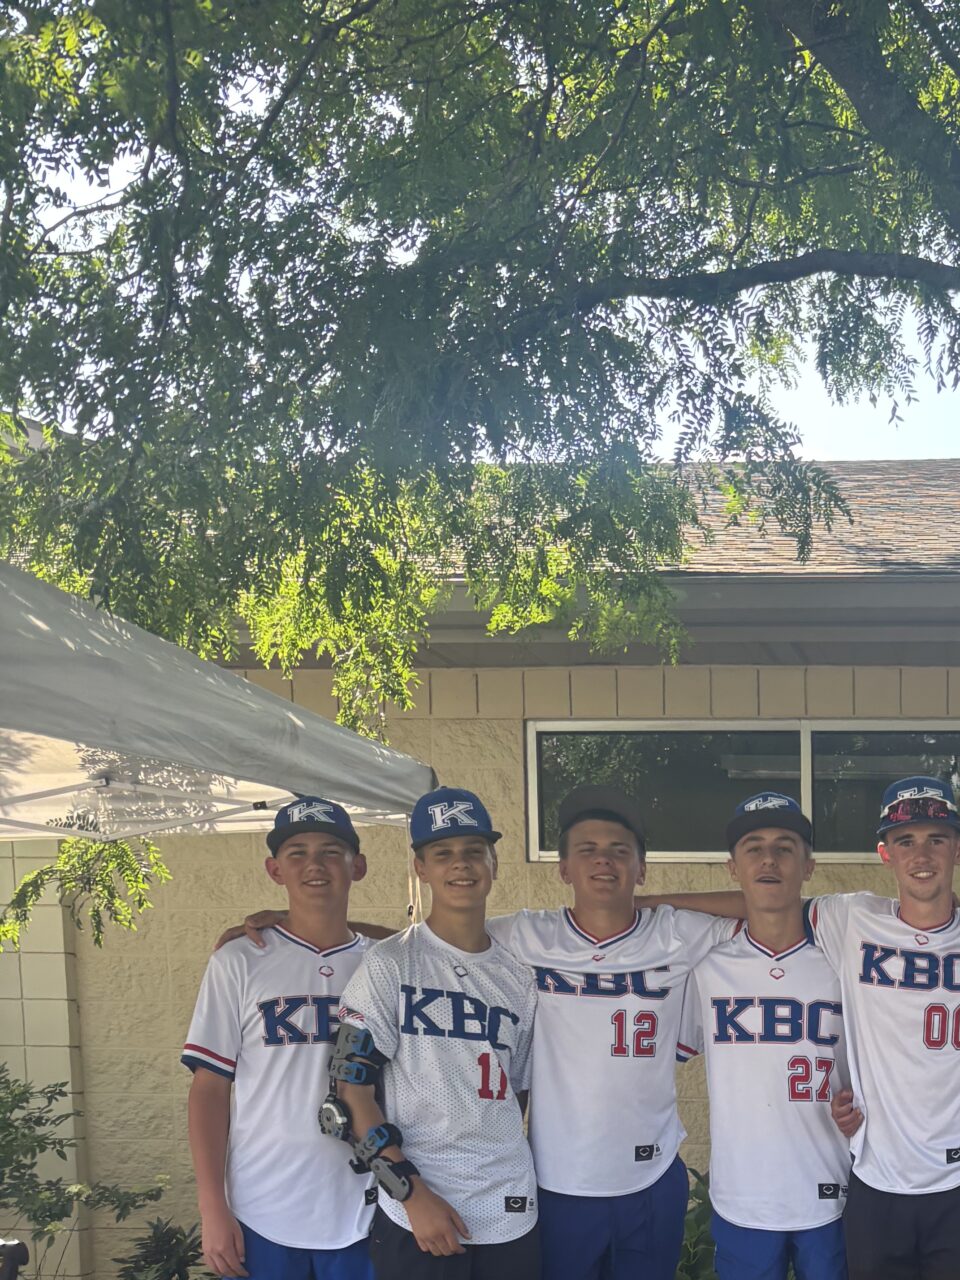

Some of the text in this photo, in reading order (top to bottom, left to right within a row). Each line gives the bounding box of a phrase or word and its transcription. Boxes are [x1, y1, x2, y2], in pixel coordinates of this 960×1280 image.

[428, 801, 478, 832] K
[400, 984, 520, 1051] KBC
[611, 1009, 658, 1057] 12
[710, 996, 843, 1048] KBC
[787, 1055, 835, 1102] 27
